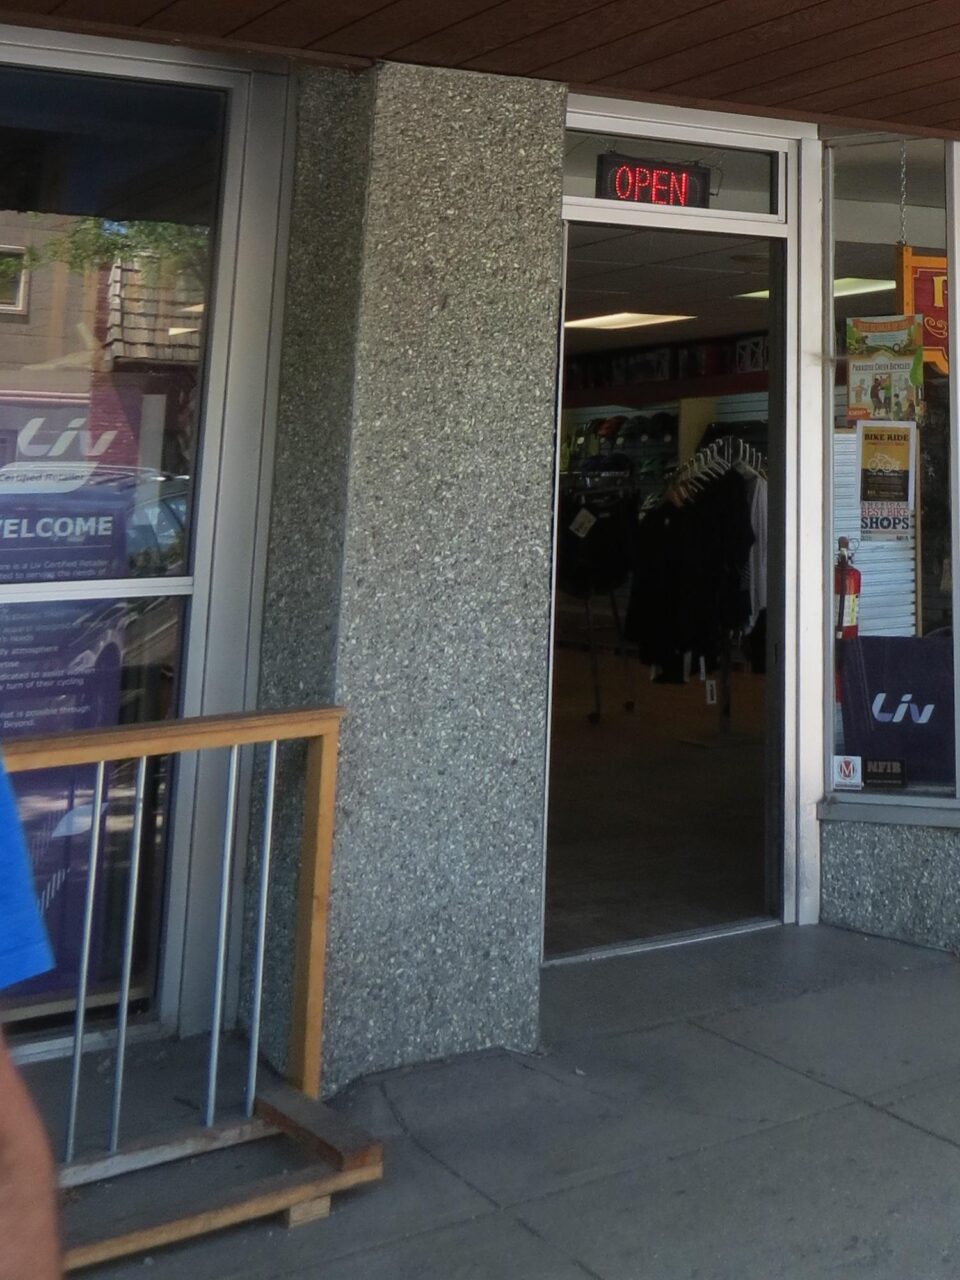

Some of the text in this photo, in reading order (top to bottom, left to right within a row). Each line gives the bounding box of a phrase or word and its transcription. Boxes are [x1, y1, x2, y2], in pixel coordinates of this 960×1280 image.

[615, 164, 688, 207] OPEN
[17, 417, 119, 457] Liv
[860, 516, 910, 530] SHOPS
[861, 507, 909, 517] BEST BIKE
[0, 516, 113, 539] ELCOME
[871, 692, 936, 724] Liv
[866, 760, 902, 773] NFIB
